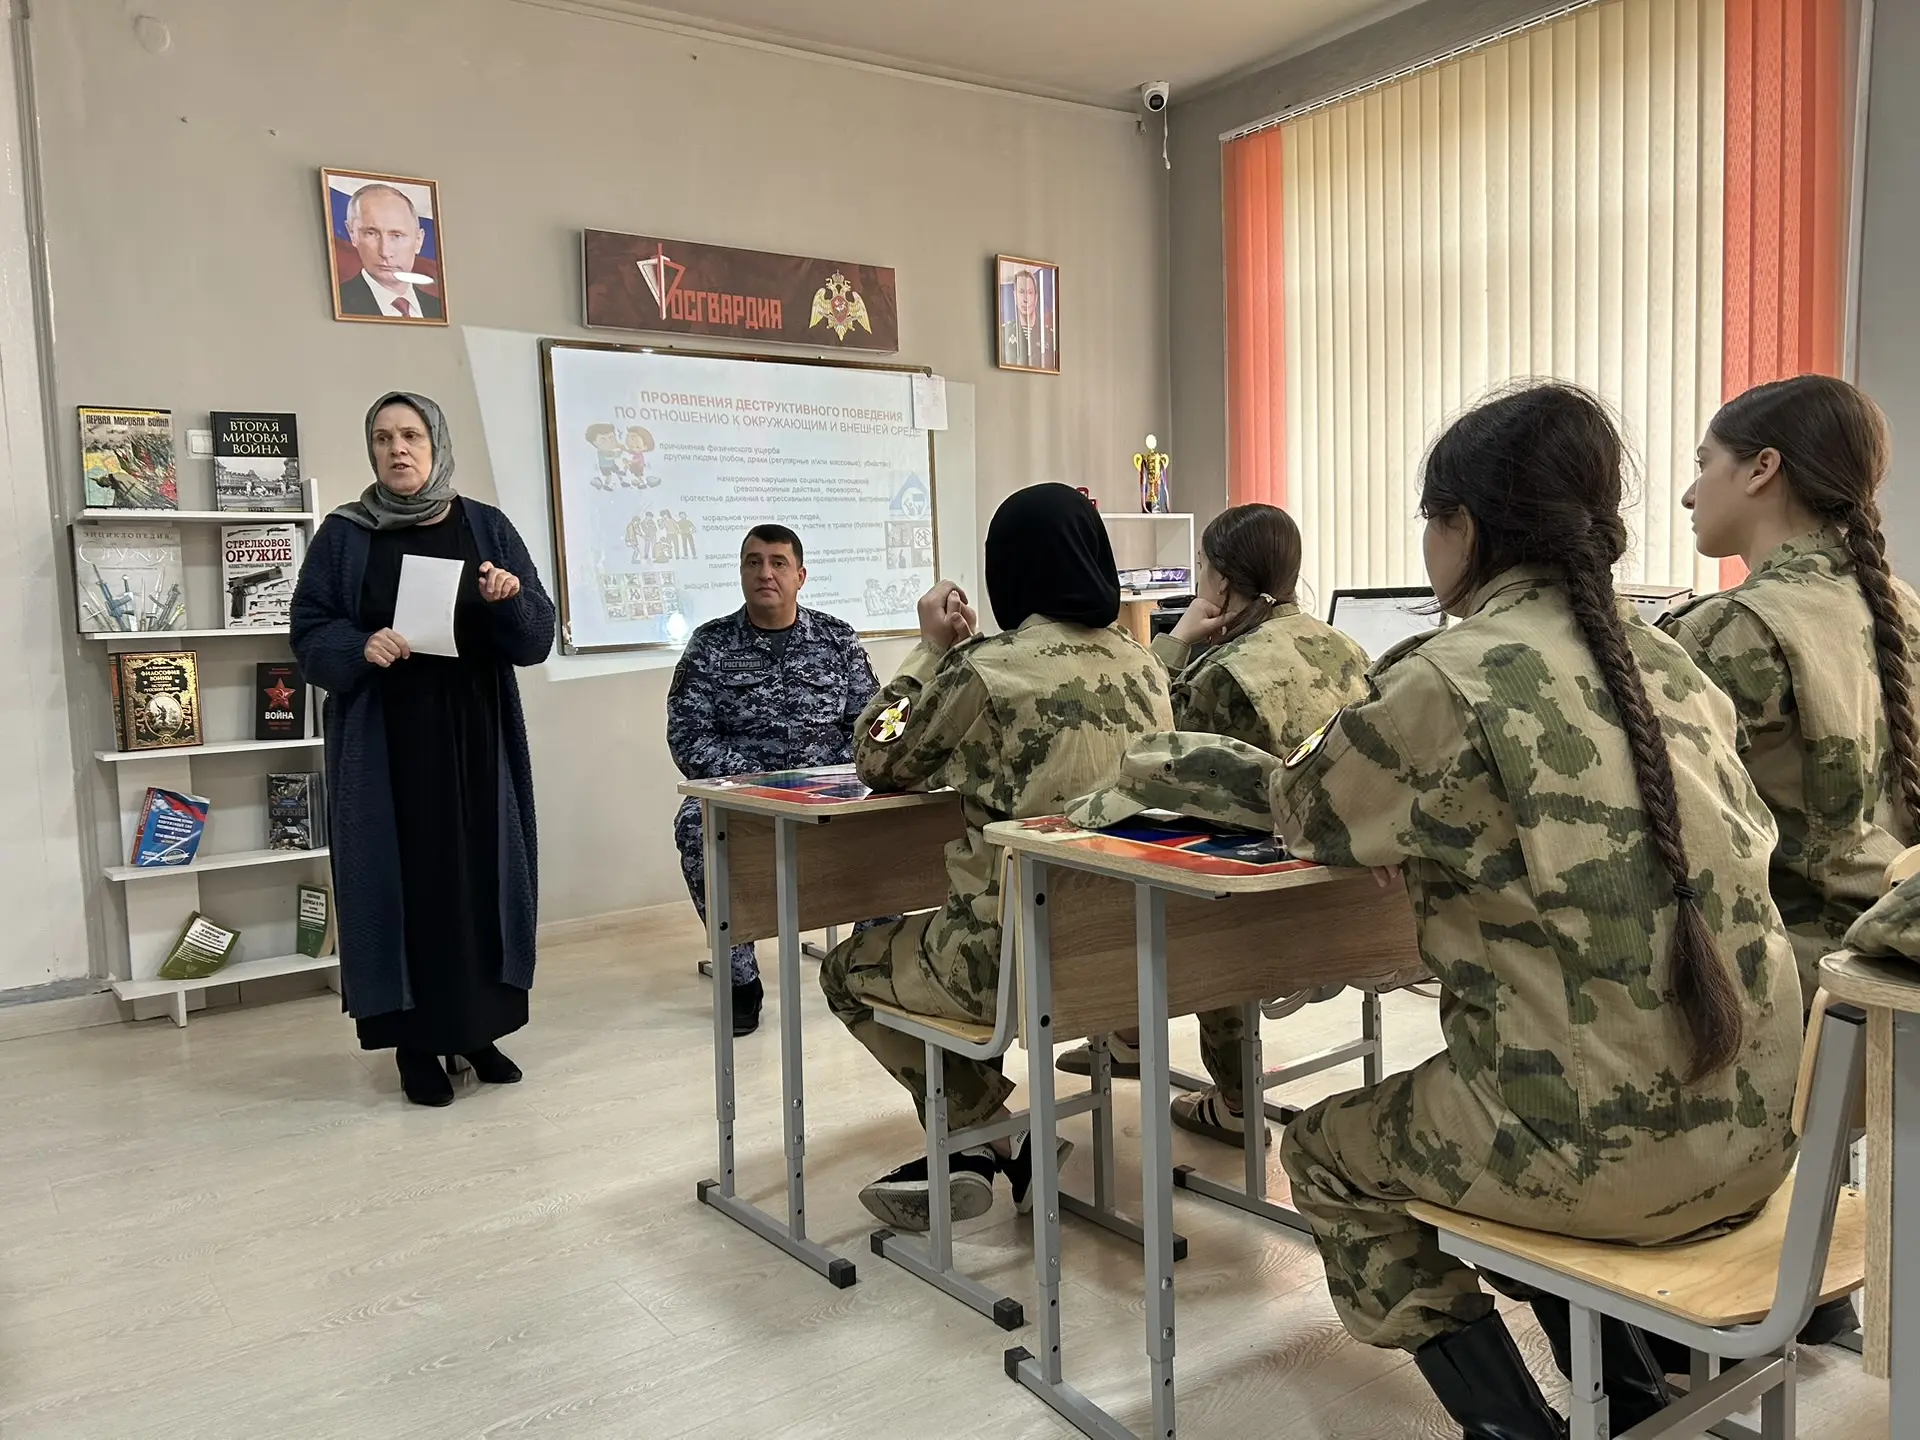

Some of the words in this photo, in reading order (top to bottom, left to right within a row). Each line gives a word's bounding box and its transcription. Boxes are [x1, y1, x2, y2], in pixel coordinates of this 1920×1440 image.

[640, 390, 733, 409] ПРОЯВЛЕНИЯ
[735, 398, 840, 418] ДЕСТРУКТИВНОГО
[841, 407, 903, 422] ПОВЕДЕНИЯ
[86, 414, 111, 425] ПЕРВАЯ
[113, 415, 146, 427] МИРОВАЯ
[147, 416, 170, 428] ВОЙНА
[229, 420, 280, 432] ВТОРАЯ
[614, 406, 637, 419] ПО
[639, 407, 730, 425] ОТНОШЕНИЮ
[732, 415, 741, 427] К
[742, 415, 828, 432] ОКРУЖАЮЩИМ
[829, 421, 838, 432] И
[839, 421, 889, 436] ВНЕШНЕЙ
[890, 425, 922, 438] СРЕДЕ
[222, 432, 289, 444] МИРОВАЯ
[232, 443, 282, 455] ВОЙНА
[706, 443, 753, 454] физического
[753, 446, 781, 457] ущерба
[82, 531, 171, 540] ЭНЦИКЛОПЕДИЯ
[225, 538, 291, 549] СТРЕЛКОВОЕ
[225, 548, 292, 562] ОРУЖИЕ
[265, 710, 294, 720] ВОЙНА
